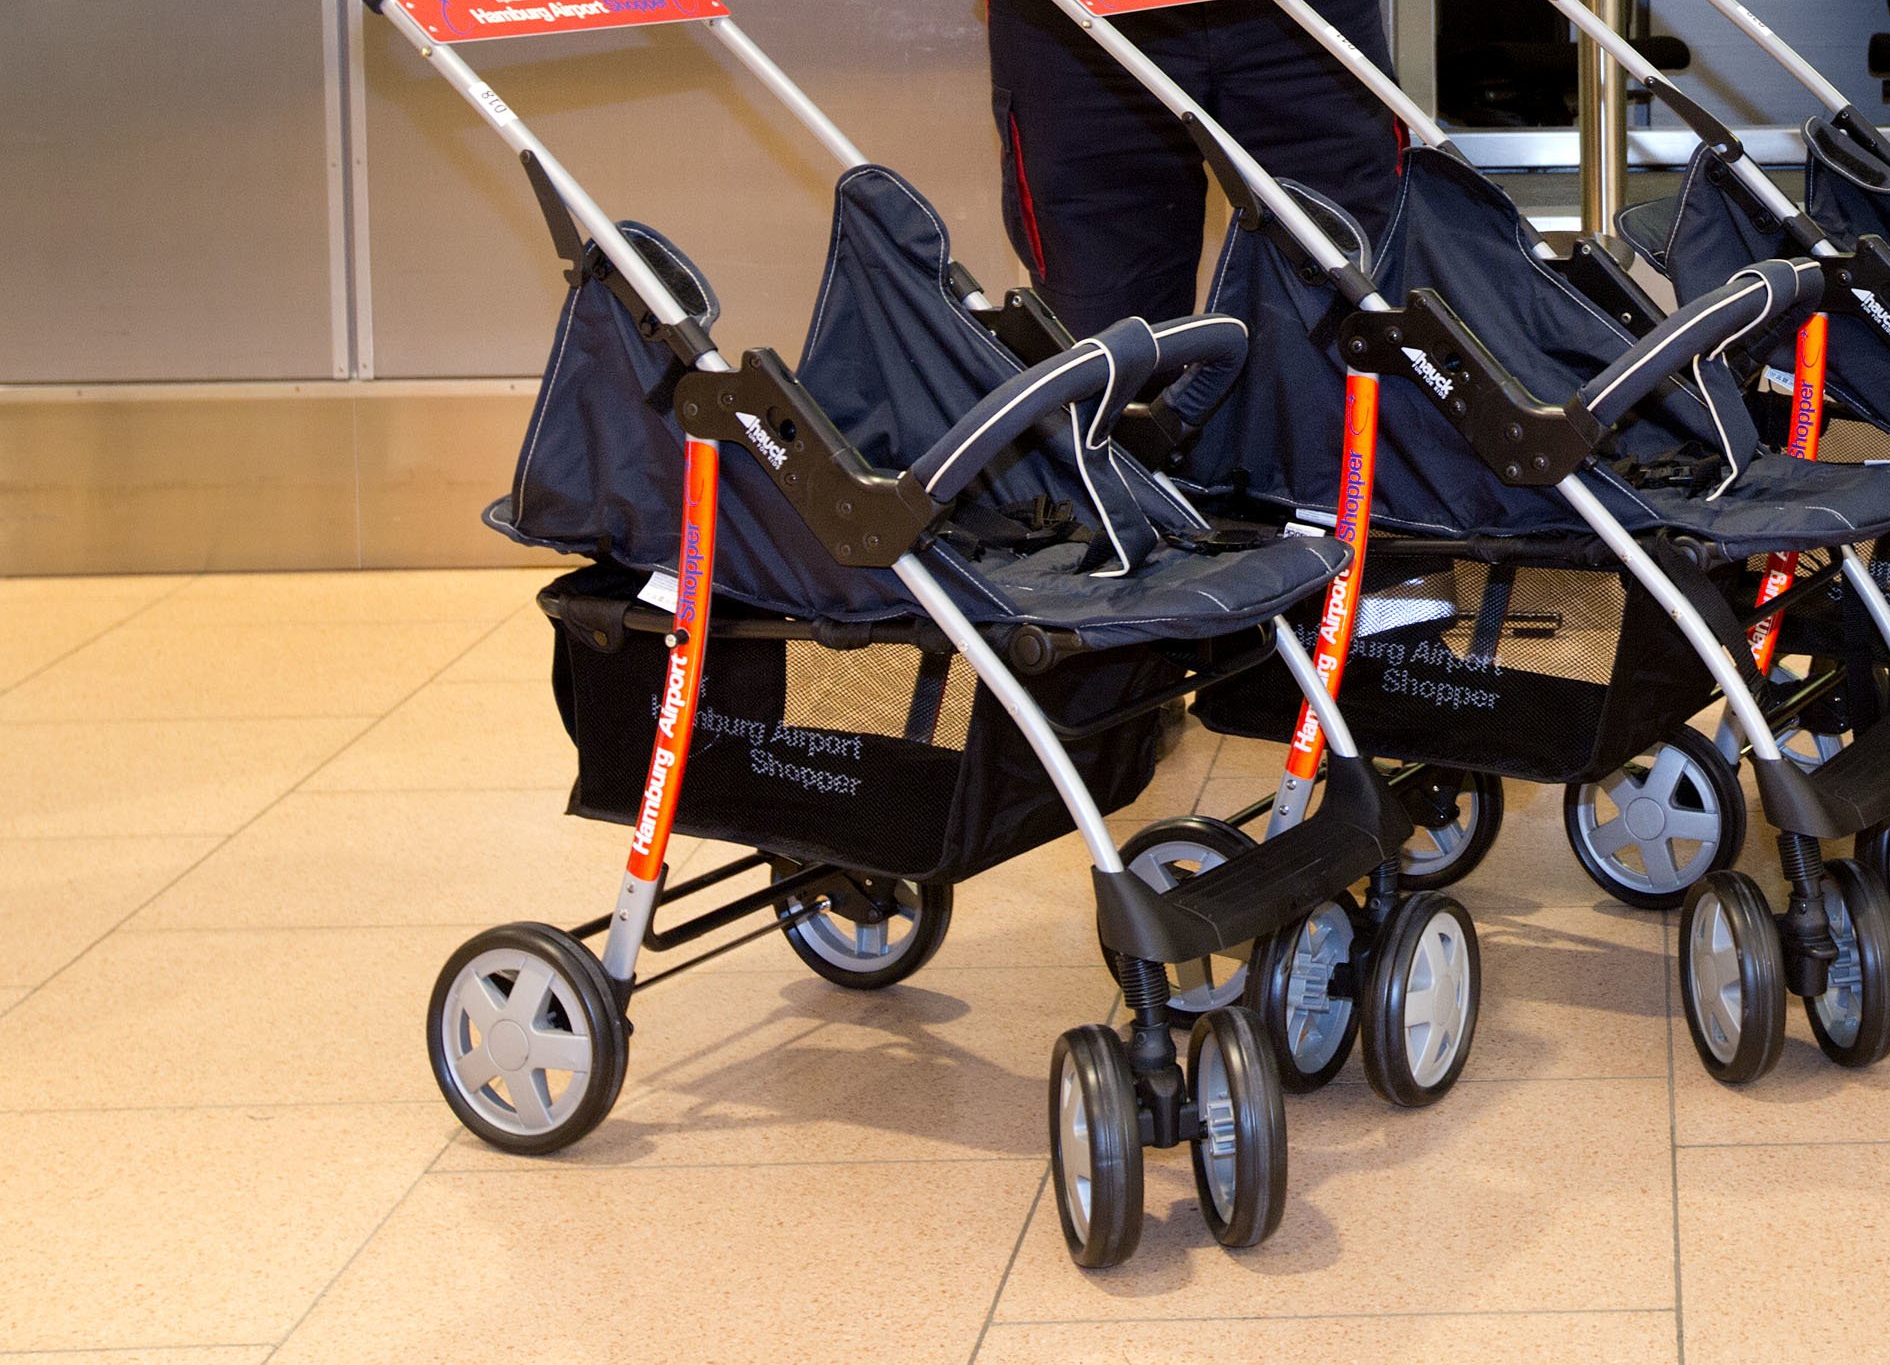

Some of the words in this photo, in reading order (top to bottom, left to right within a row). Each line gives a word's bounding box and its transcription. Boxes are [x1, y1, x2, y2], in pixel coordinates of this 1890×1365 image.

[469, 6, 555, 24] Hamburg
[548, 0, 610, 19] Airport
[1414, 352, 1454, 396] hauck
[748, 418, 789, 466] hauck
[1787, 378, 1815, 460] Shopper
[1337, 449, 1368, 543] Shopper
[631, 747, 676, 856] Hamburg
[658, 651, 689, 740] Airport
[676, 522, 701, 623] Shopper
[1382, 667, 1501, 710] Shopper
[769, 719, 863, 760] Airport
[750, 748, 863, 796] Shopper
